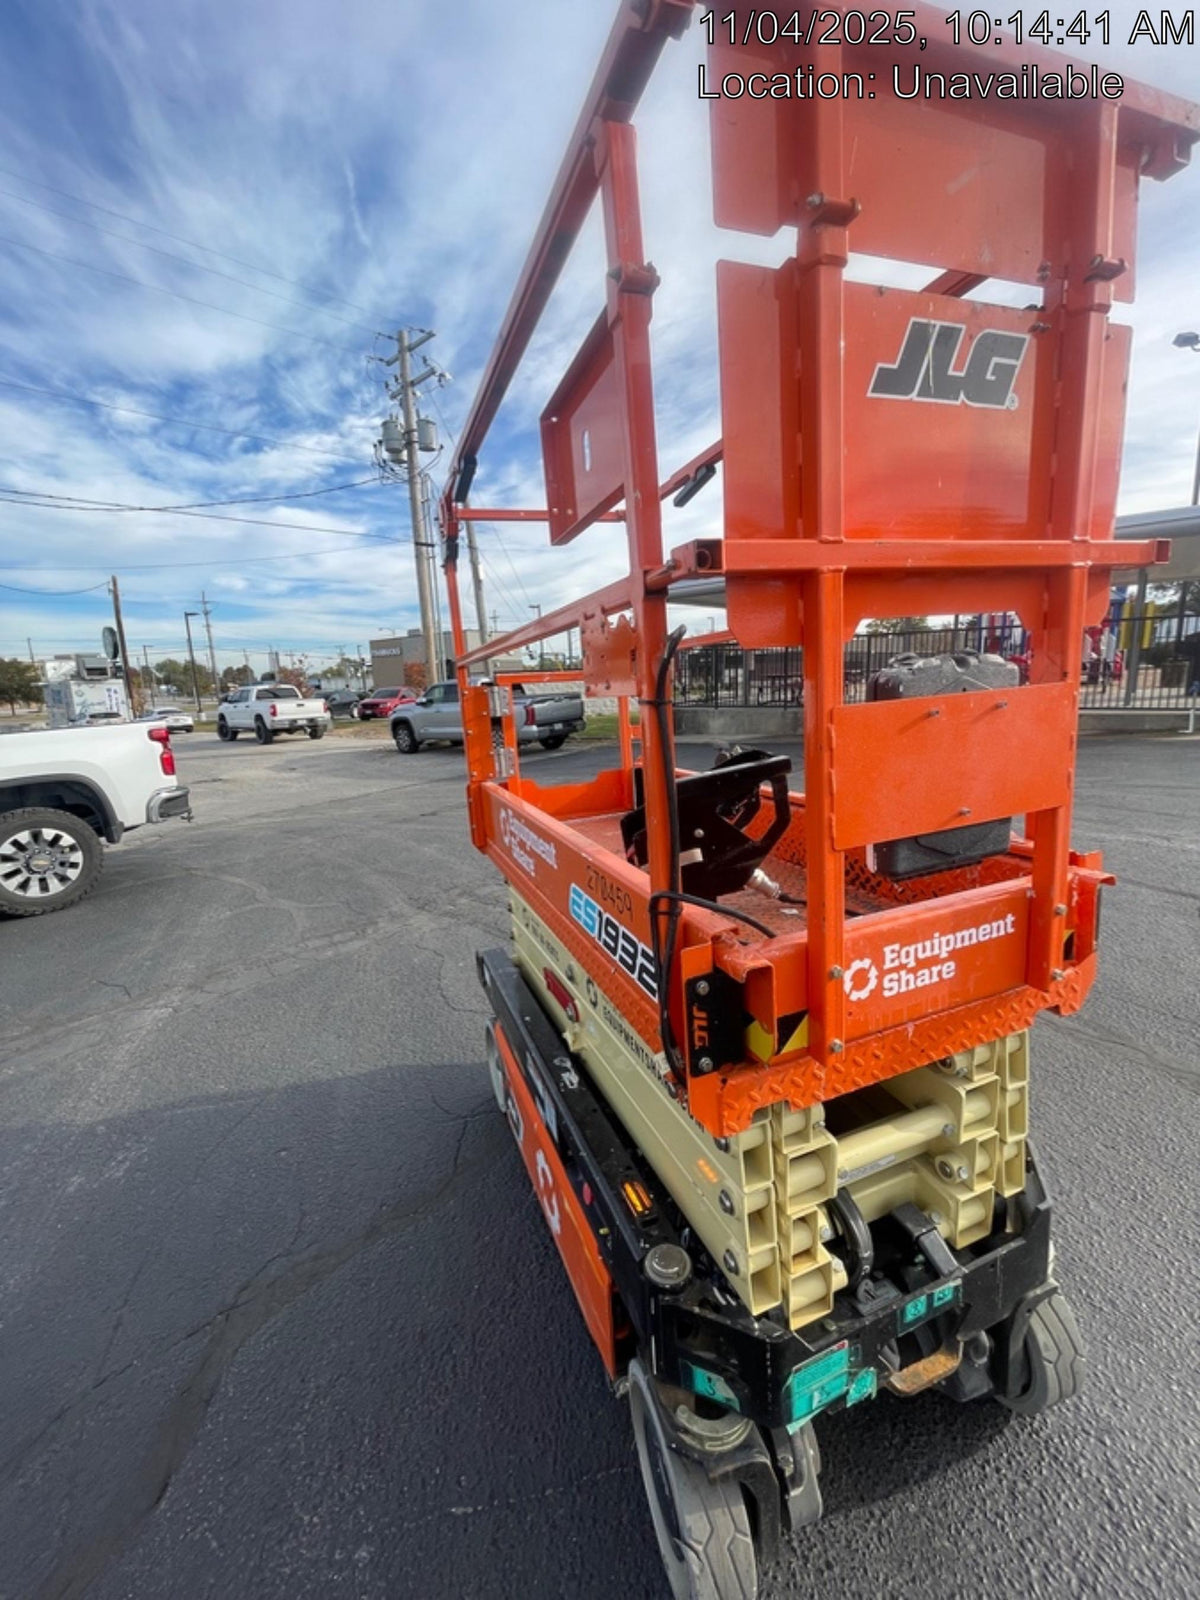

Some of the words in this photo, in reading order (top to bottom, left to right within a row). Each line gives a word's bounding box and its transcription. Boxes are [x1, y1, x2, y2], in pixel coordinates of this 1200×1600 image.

[867, 317, 1030, 409] JLG
[570, 883, 659, 1003] ES1932
[883, 913, 1015, 969] Equipment
[882, 961, 956, 997] Share
[692, 1005, 709, 1050] JLG
